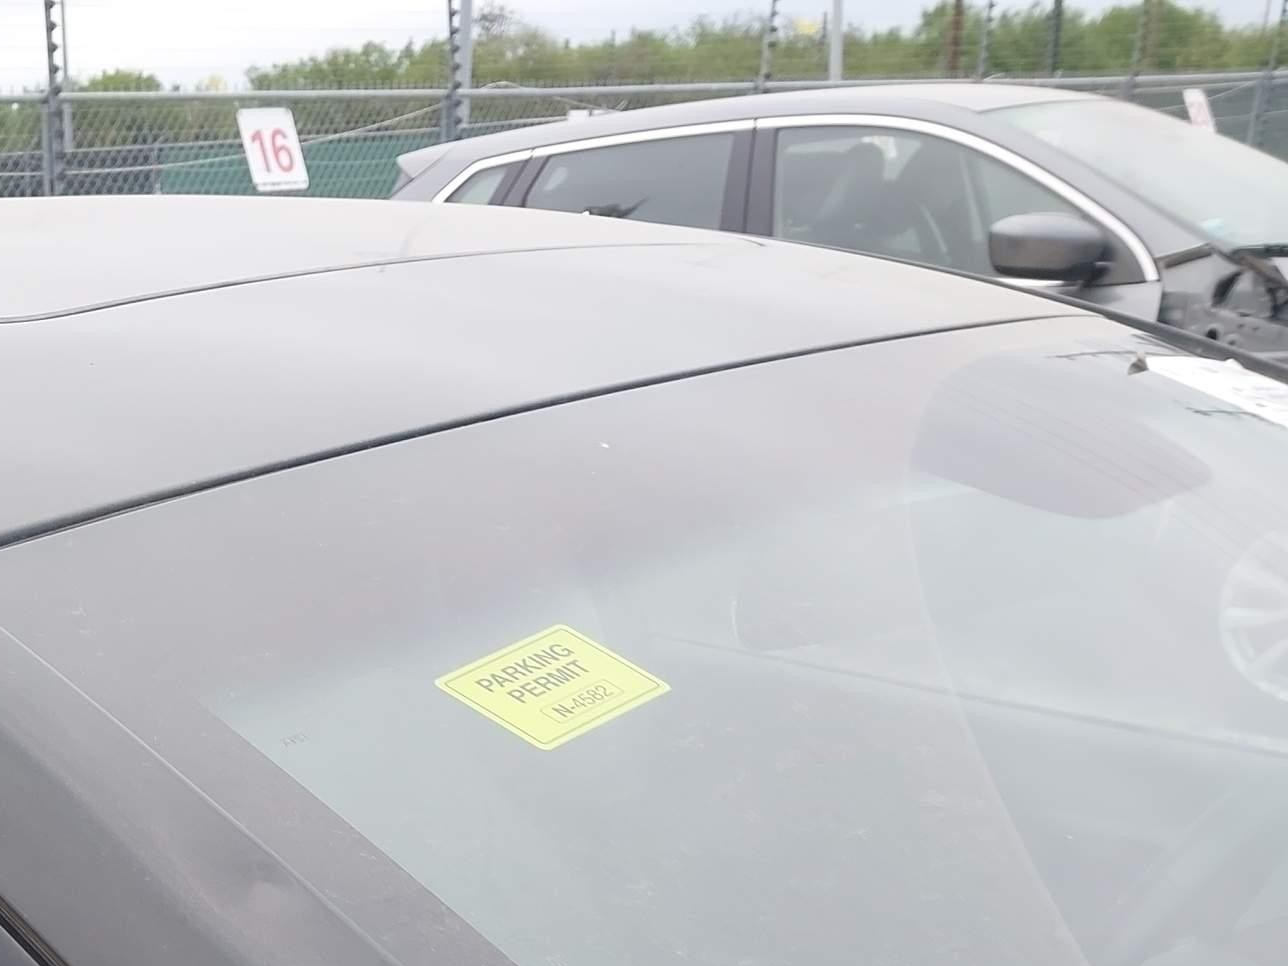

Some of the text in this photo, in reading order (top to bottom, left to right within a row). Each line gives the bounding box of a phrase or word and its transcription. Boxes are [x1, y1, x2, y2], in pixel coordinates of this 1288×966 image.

[251, 128, 294, 173] 16
[475, 643, 576, 693] PARKING
[507, 659, 591, 704] PERMIT
[551, 684, 615, 719] N-4582
